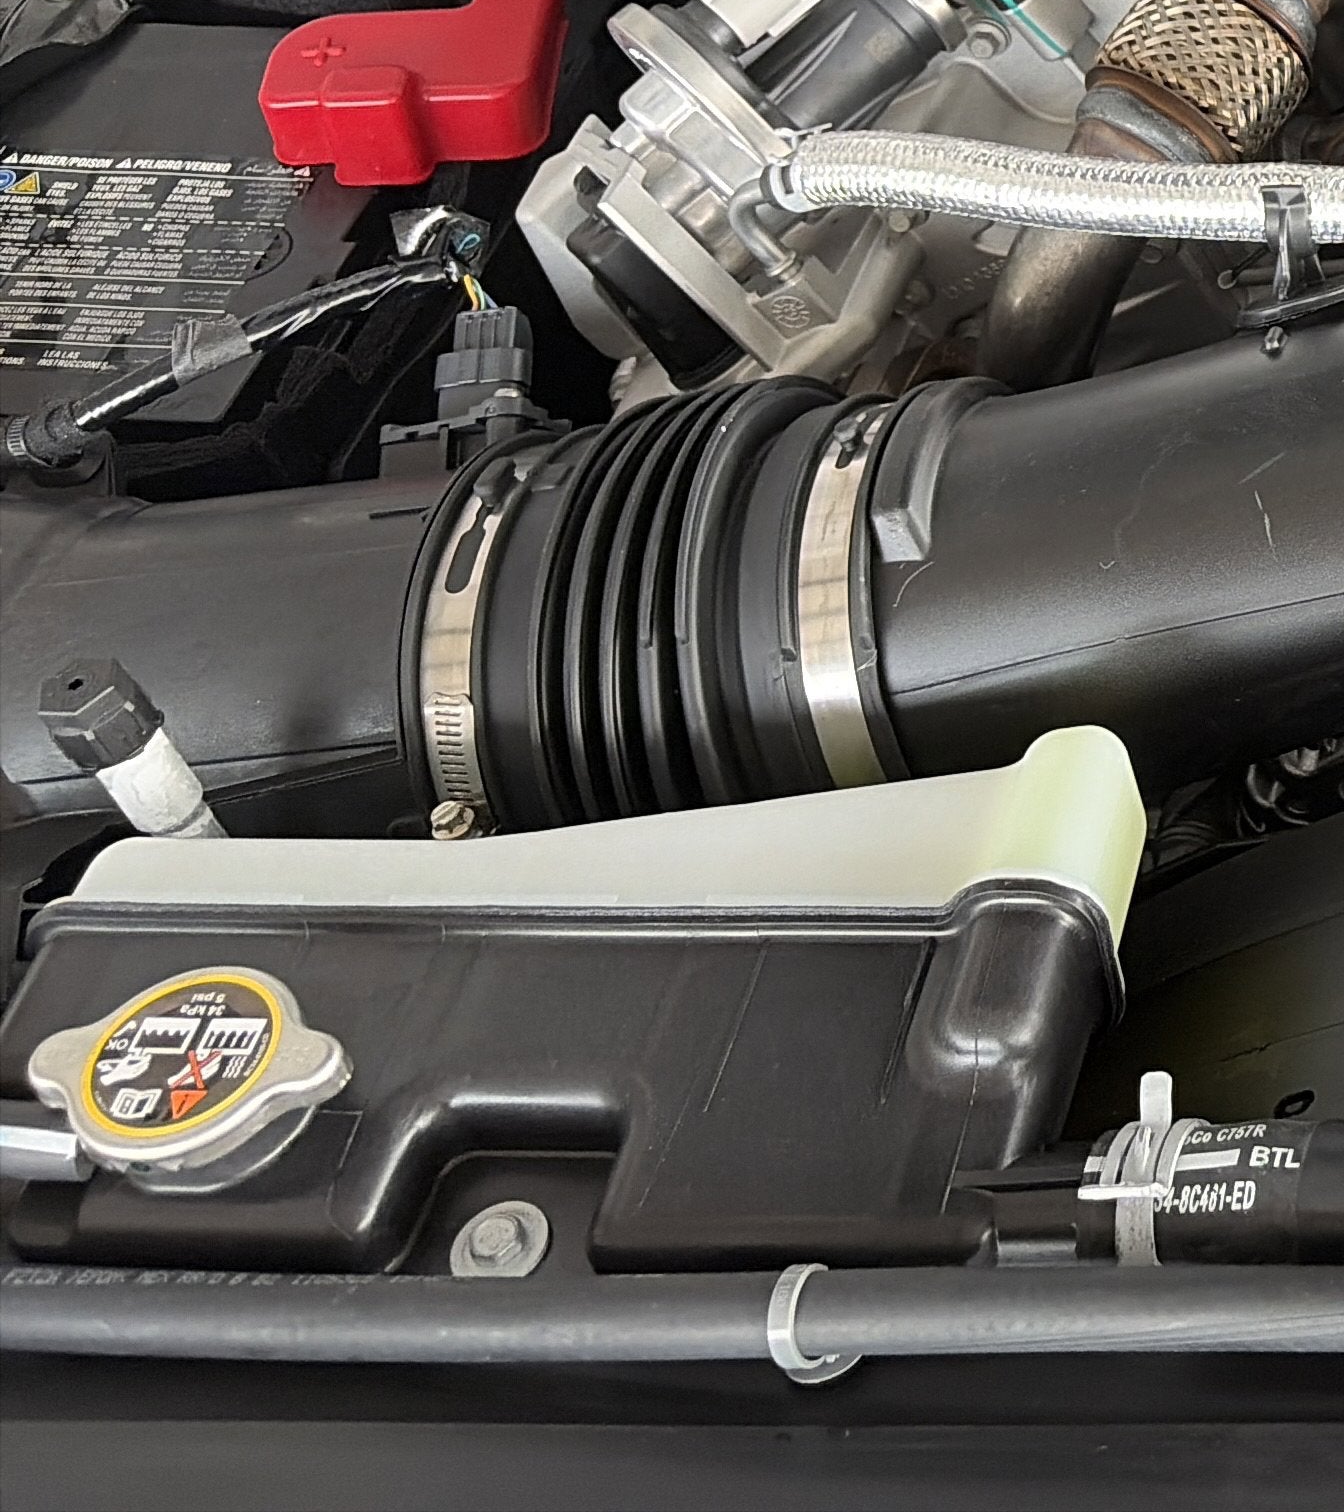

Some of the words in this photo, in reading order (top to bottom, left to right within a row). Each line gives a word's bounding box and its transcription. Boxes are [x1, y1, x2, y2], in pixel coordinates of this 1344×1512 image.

[20, 154, 114, 168] DANGER/POISON
[133, 159, 232, 173] PELIGRO/VENENO
[191, 991, 215, 1003] psi
[180, 1004, 207, 1016] kPa
[207, 1005, 227, 1016] 34
[104, 1038, 129, 1051] OK
[1216, 1123, 1267, 1142] C757R
[1249, 1145, 1301, 1169] BTL
